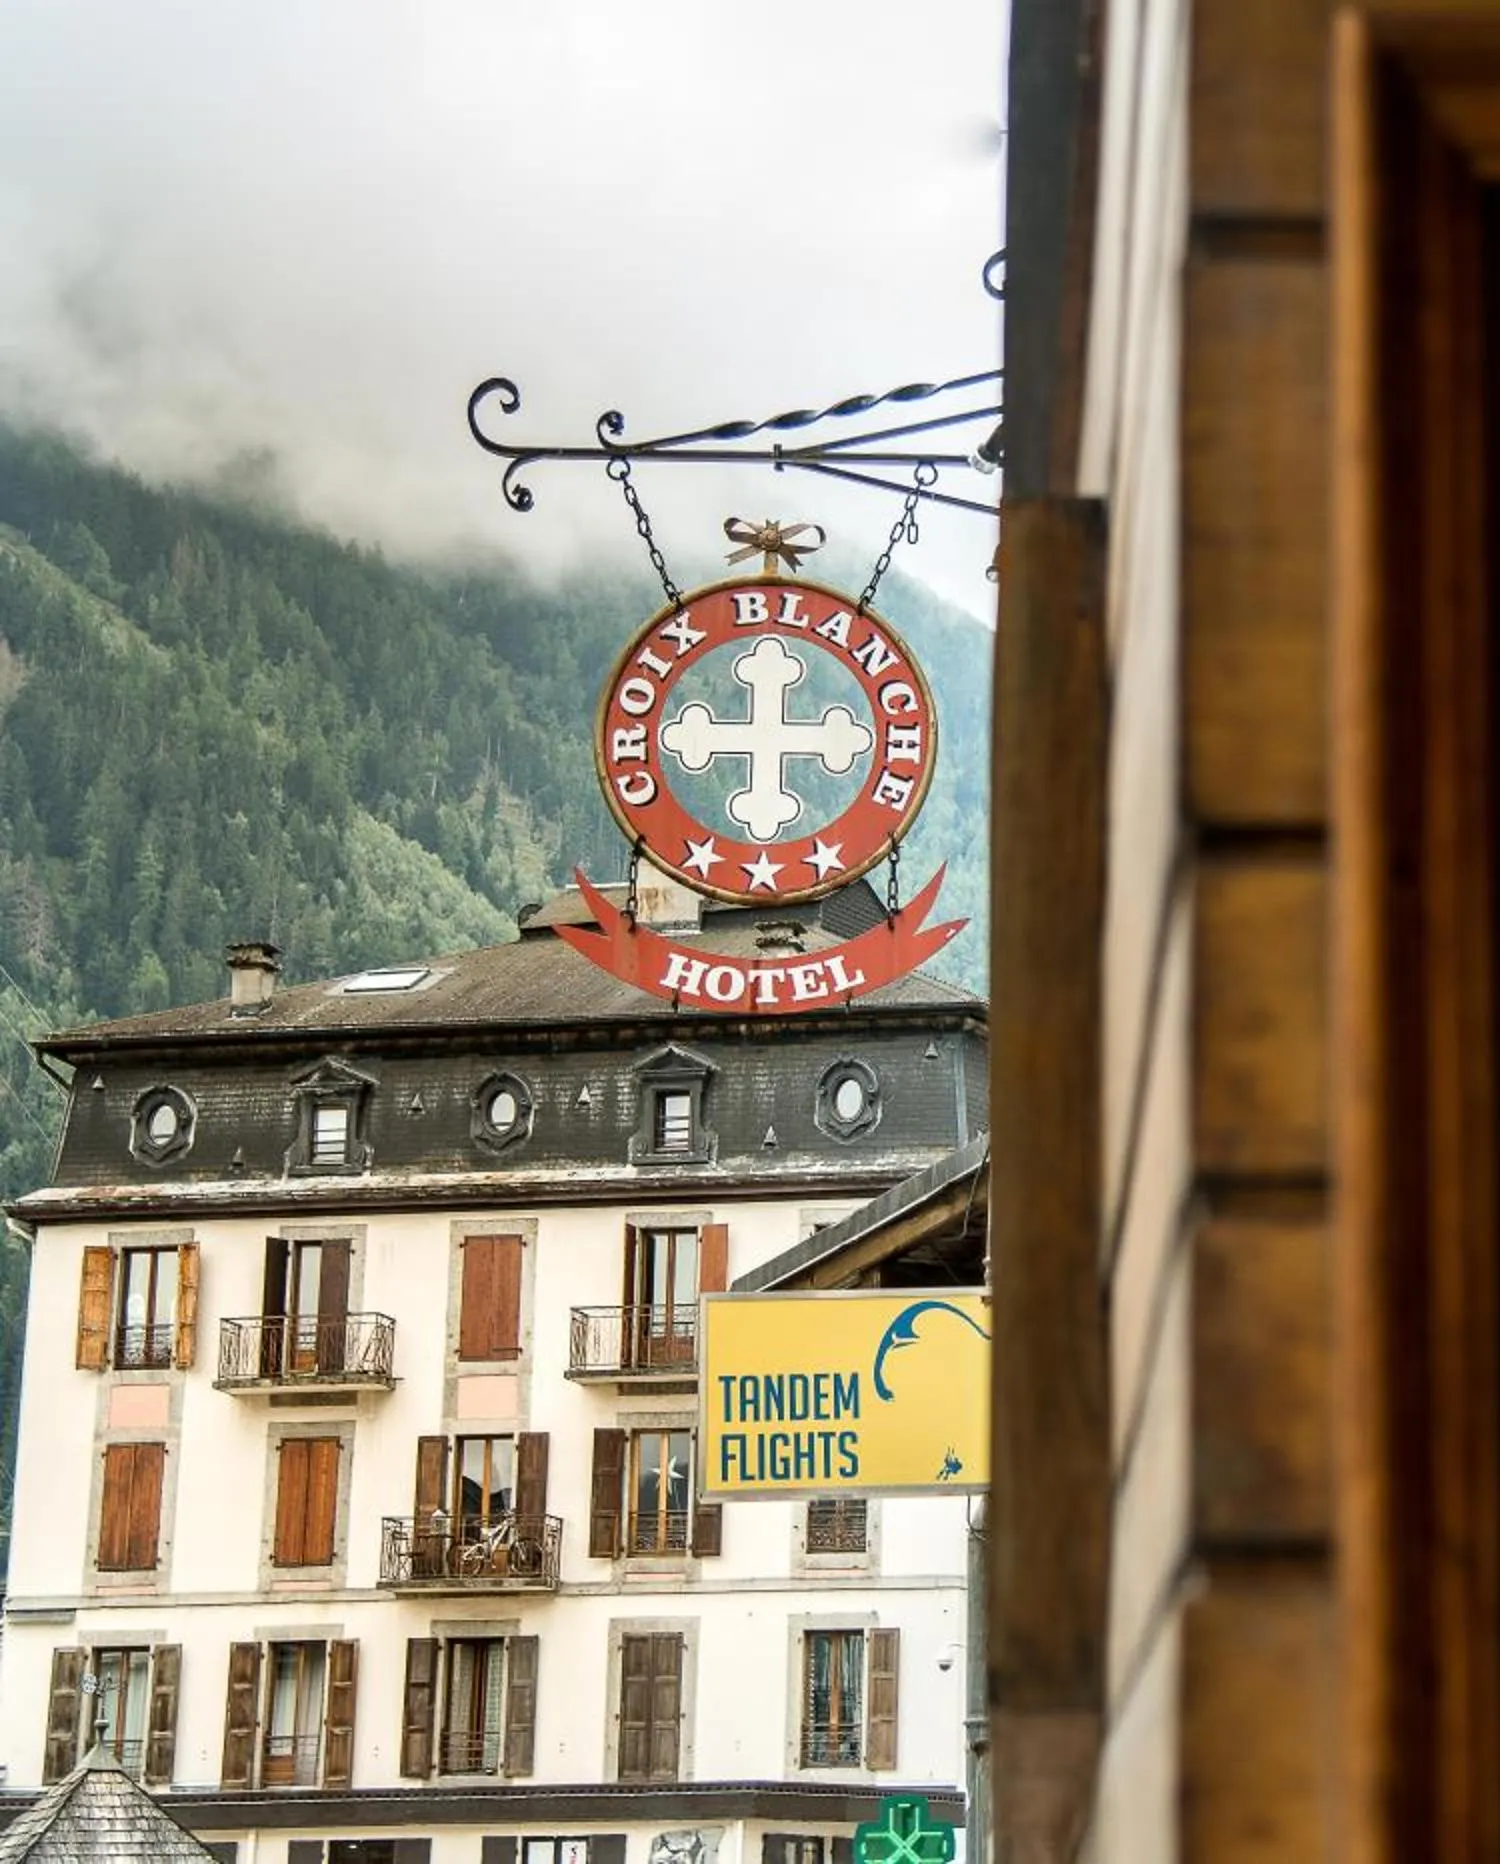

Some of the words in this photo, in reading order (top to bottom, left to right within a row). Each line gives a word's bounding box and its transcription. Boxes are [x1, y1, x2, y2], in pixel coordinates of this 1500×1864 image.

[612, 608, 706, 807] CROIX
[732, 591, 921, 811] BLANCHE
[659, 952, 865, 1004] HOTEL
[718, 1372, 860, 1423] TANDEM
[720, 1431, 859, 1483] FLIGHTS
